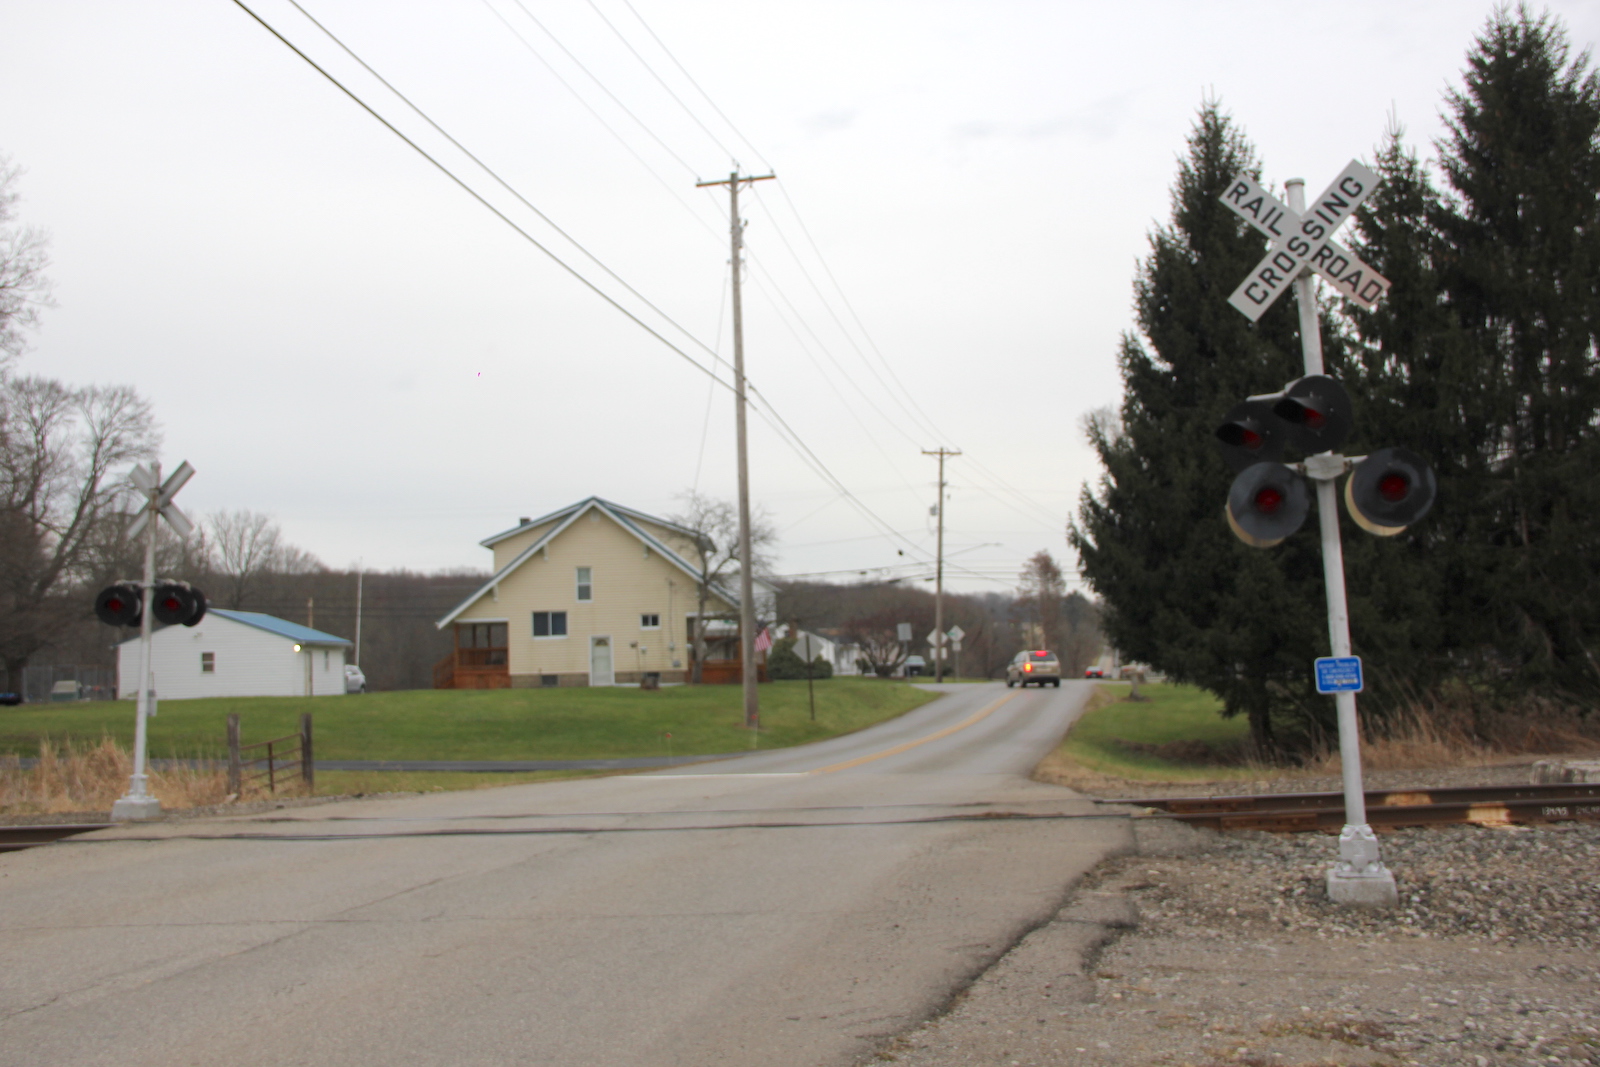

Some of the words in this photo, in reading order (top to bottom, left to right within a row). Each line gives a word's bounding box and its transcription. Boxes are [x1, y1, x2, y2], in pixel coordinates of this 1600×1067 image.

[1226, 181, 1284, 237] RAIL
[1311, 243, 1383, 303] ROAD
[1244, 176, 1363, 305] CROSSING
